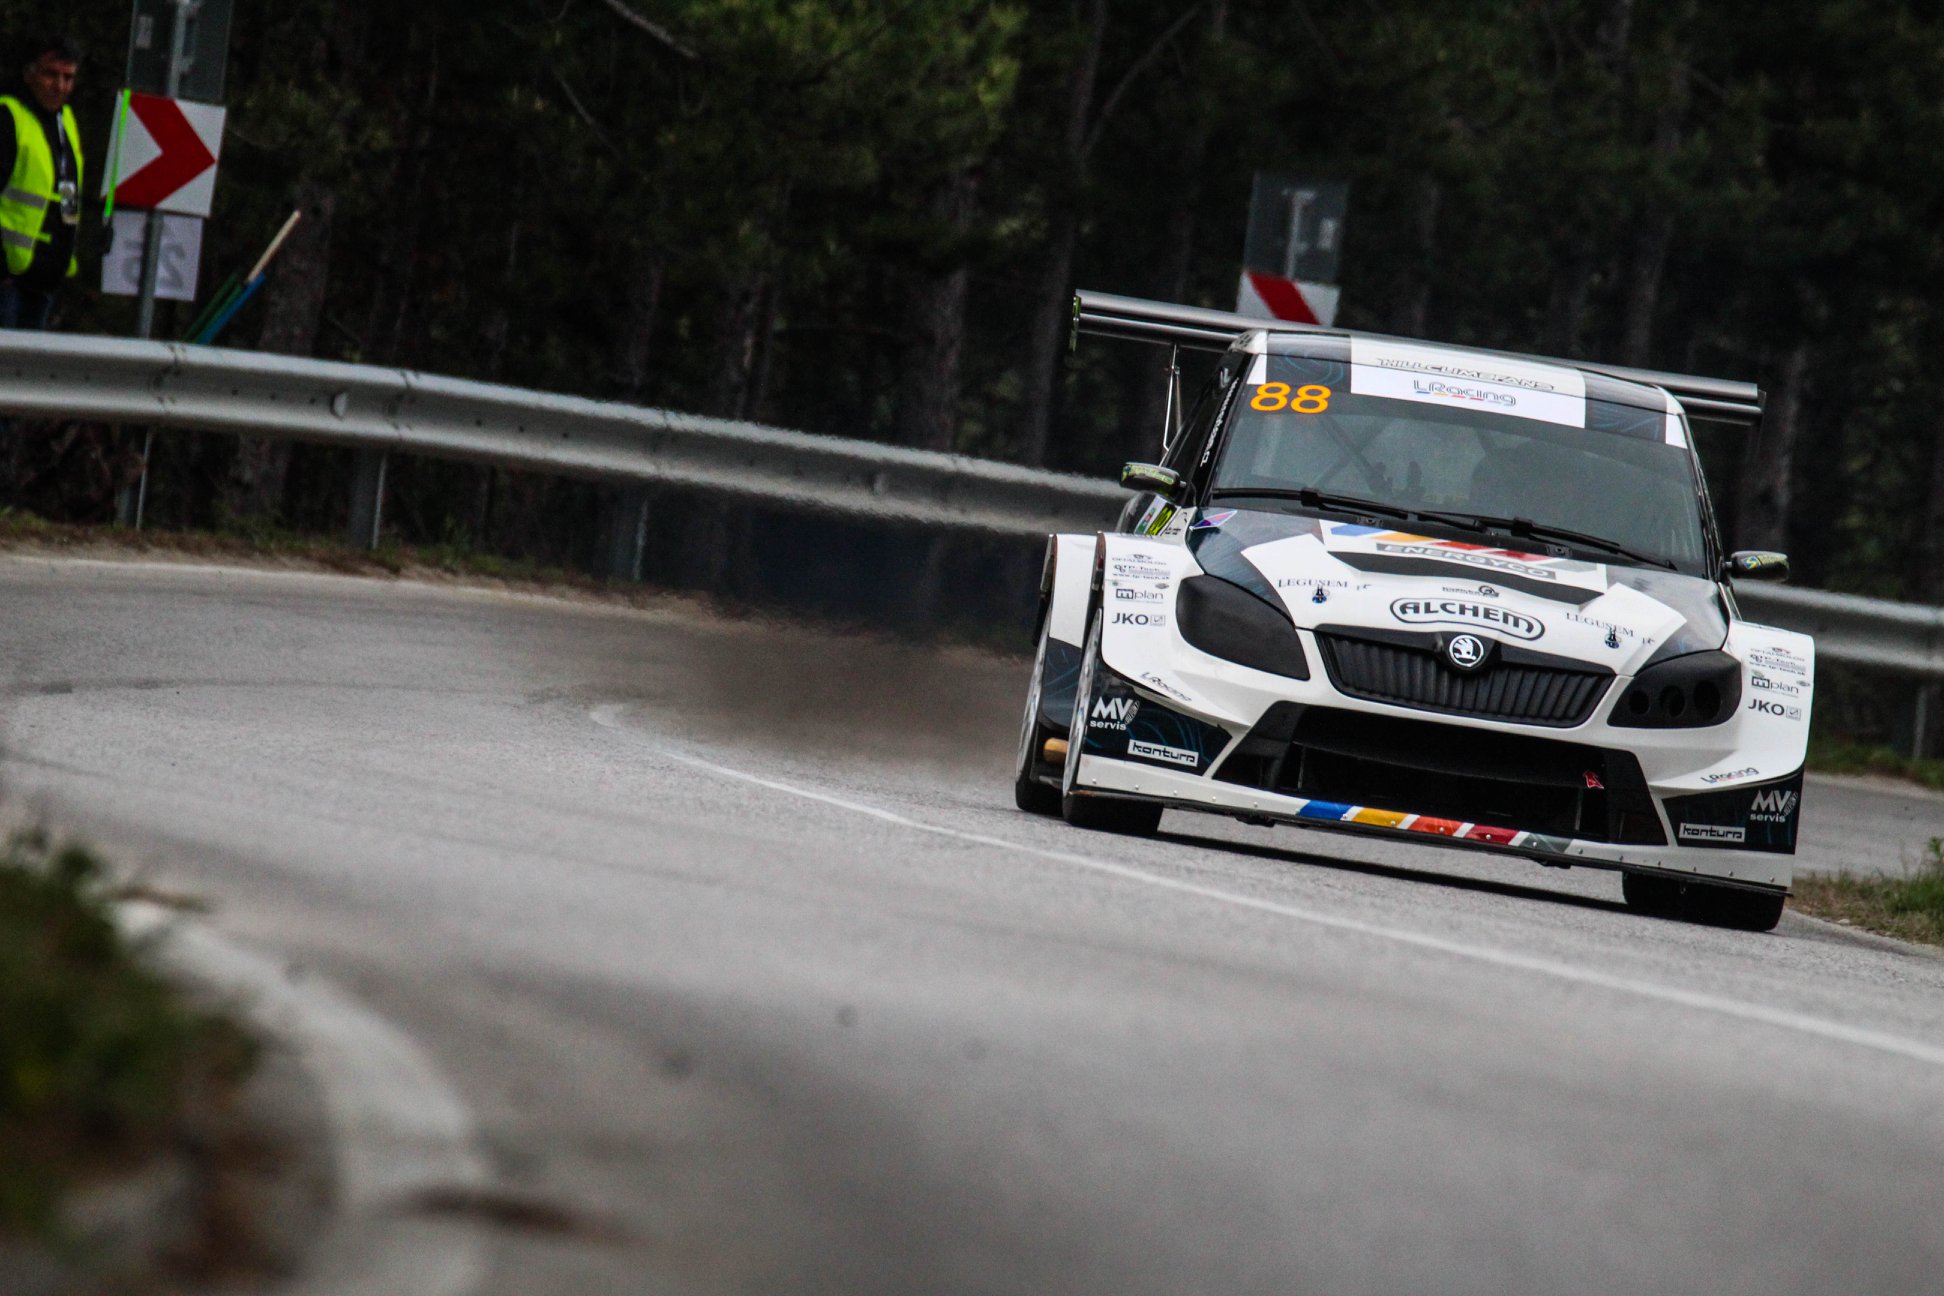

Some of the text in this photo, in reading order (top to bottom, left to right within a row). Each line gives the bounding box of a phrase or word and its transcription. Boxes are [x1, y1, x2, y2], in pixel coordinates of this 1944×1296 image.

[1250, 382, 1332, 414] 88
[1384, 544, 1550, 577] ENERGYCO
[1278, 579, 1348, 588] LEGUSEM
[1111, 612, 1149, 625] JKO
[1399, 601, 1535, 635] ALCHEM
[1566, 612, 1634, 638] LEGUSEM
[1091, 696, 1134, 721] MV
[1748, 698, 1785, 716] JKO
[1089, 720, 1127, 731] servis
[1751, 789, 1792, 814] MV
[1750, 813, 1786, 823] servis
